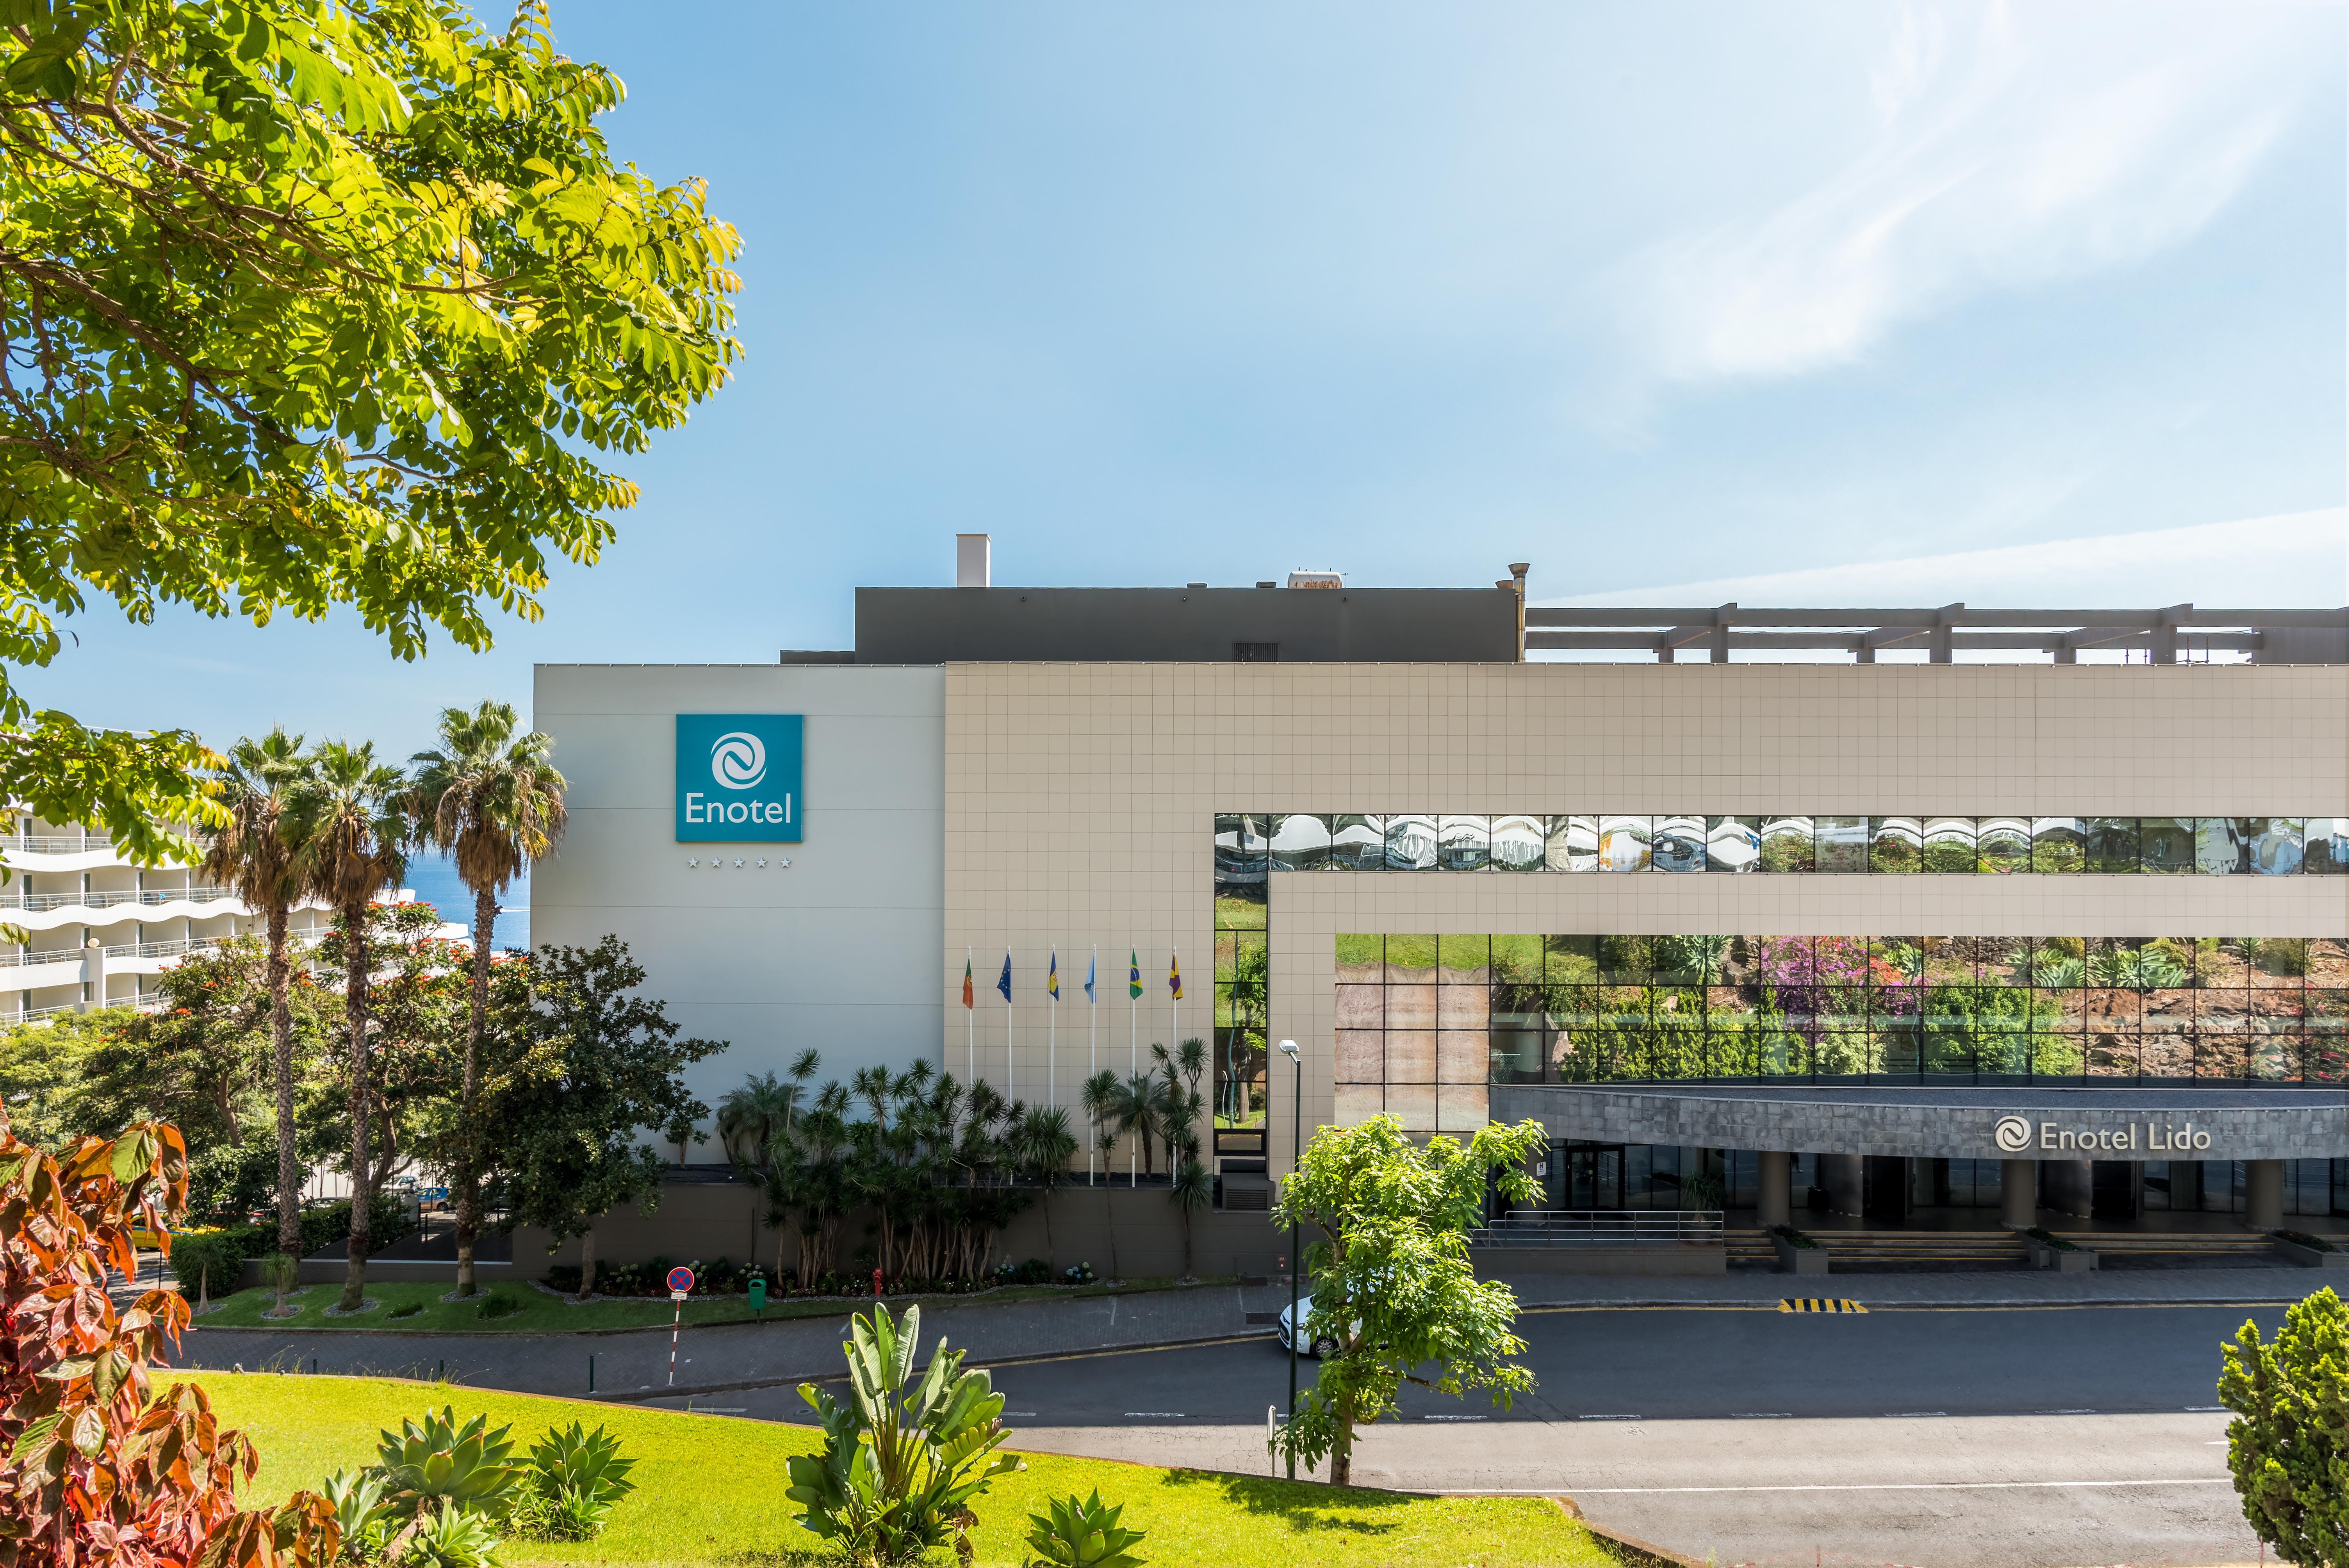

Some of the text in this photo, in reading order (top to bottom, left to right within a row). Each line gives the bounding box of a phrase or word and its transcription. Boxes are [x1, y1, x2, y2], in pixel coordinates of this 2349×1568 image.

[686, 793, 791, 823] Enotel
[2041, 1123, 2211, 1149] Enotel Lido
